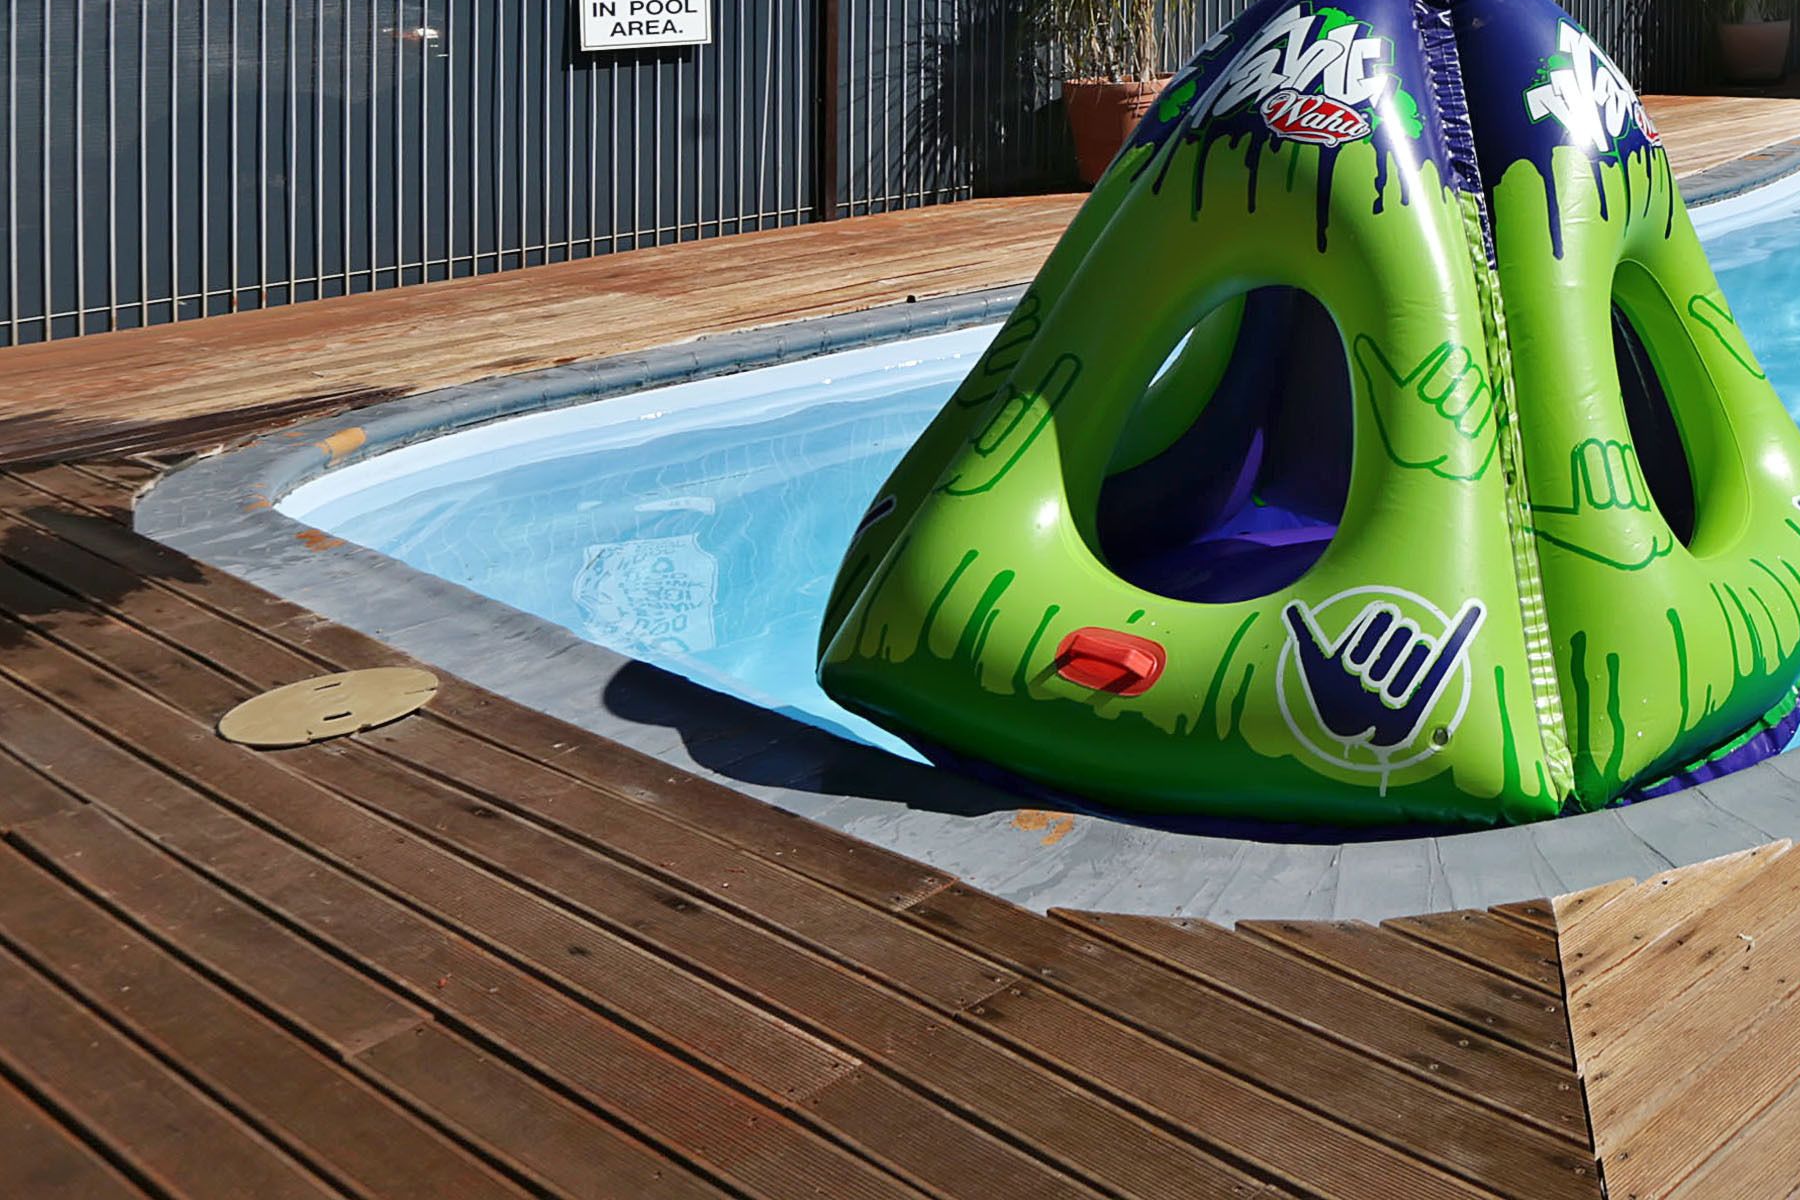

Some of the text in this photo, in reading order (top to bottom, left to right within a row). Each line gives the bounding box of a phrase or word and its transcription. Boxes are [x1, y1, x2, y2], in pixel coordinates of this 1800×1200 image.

[592, 1, 616, 18] IN
[610, 19, 683, 37] AREA.
[1262, 90, 1371, 137] Wahu
